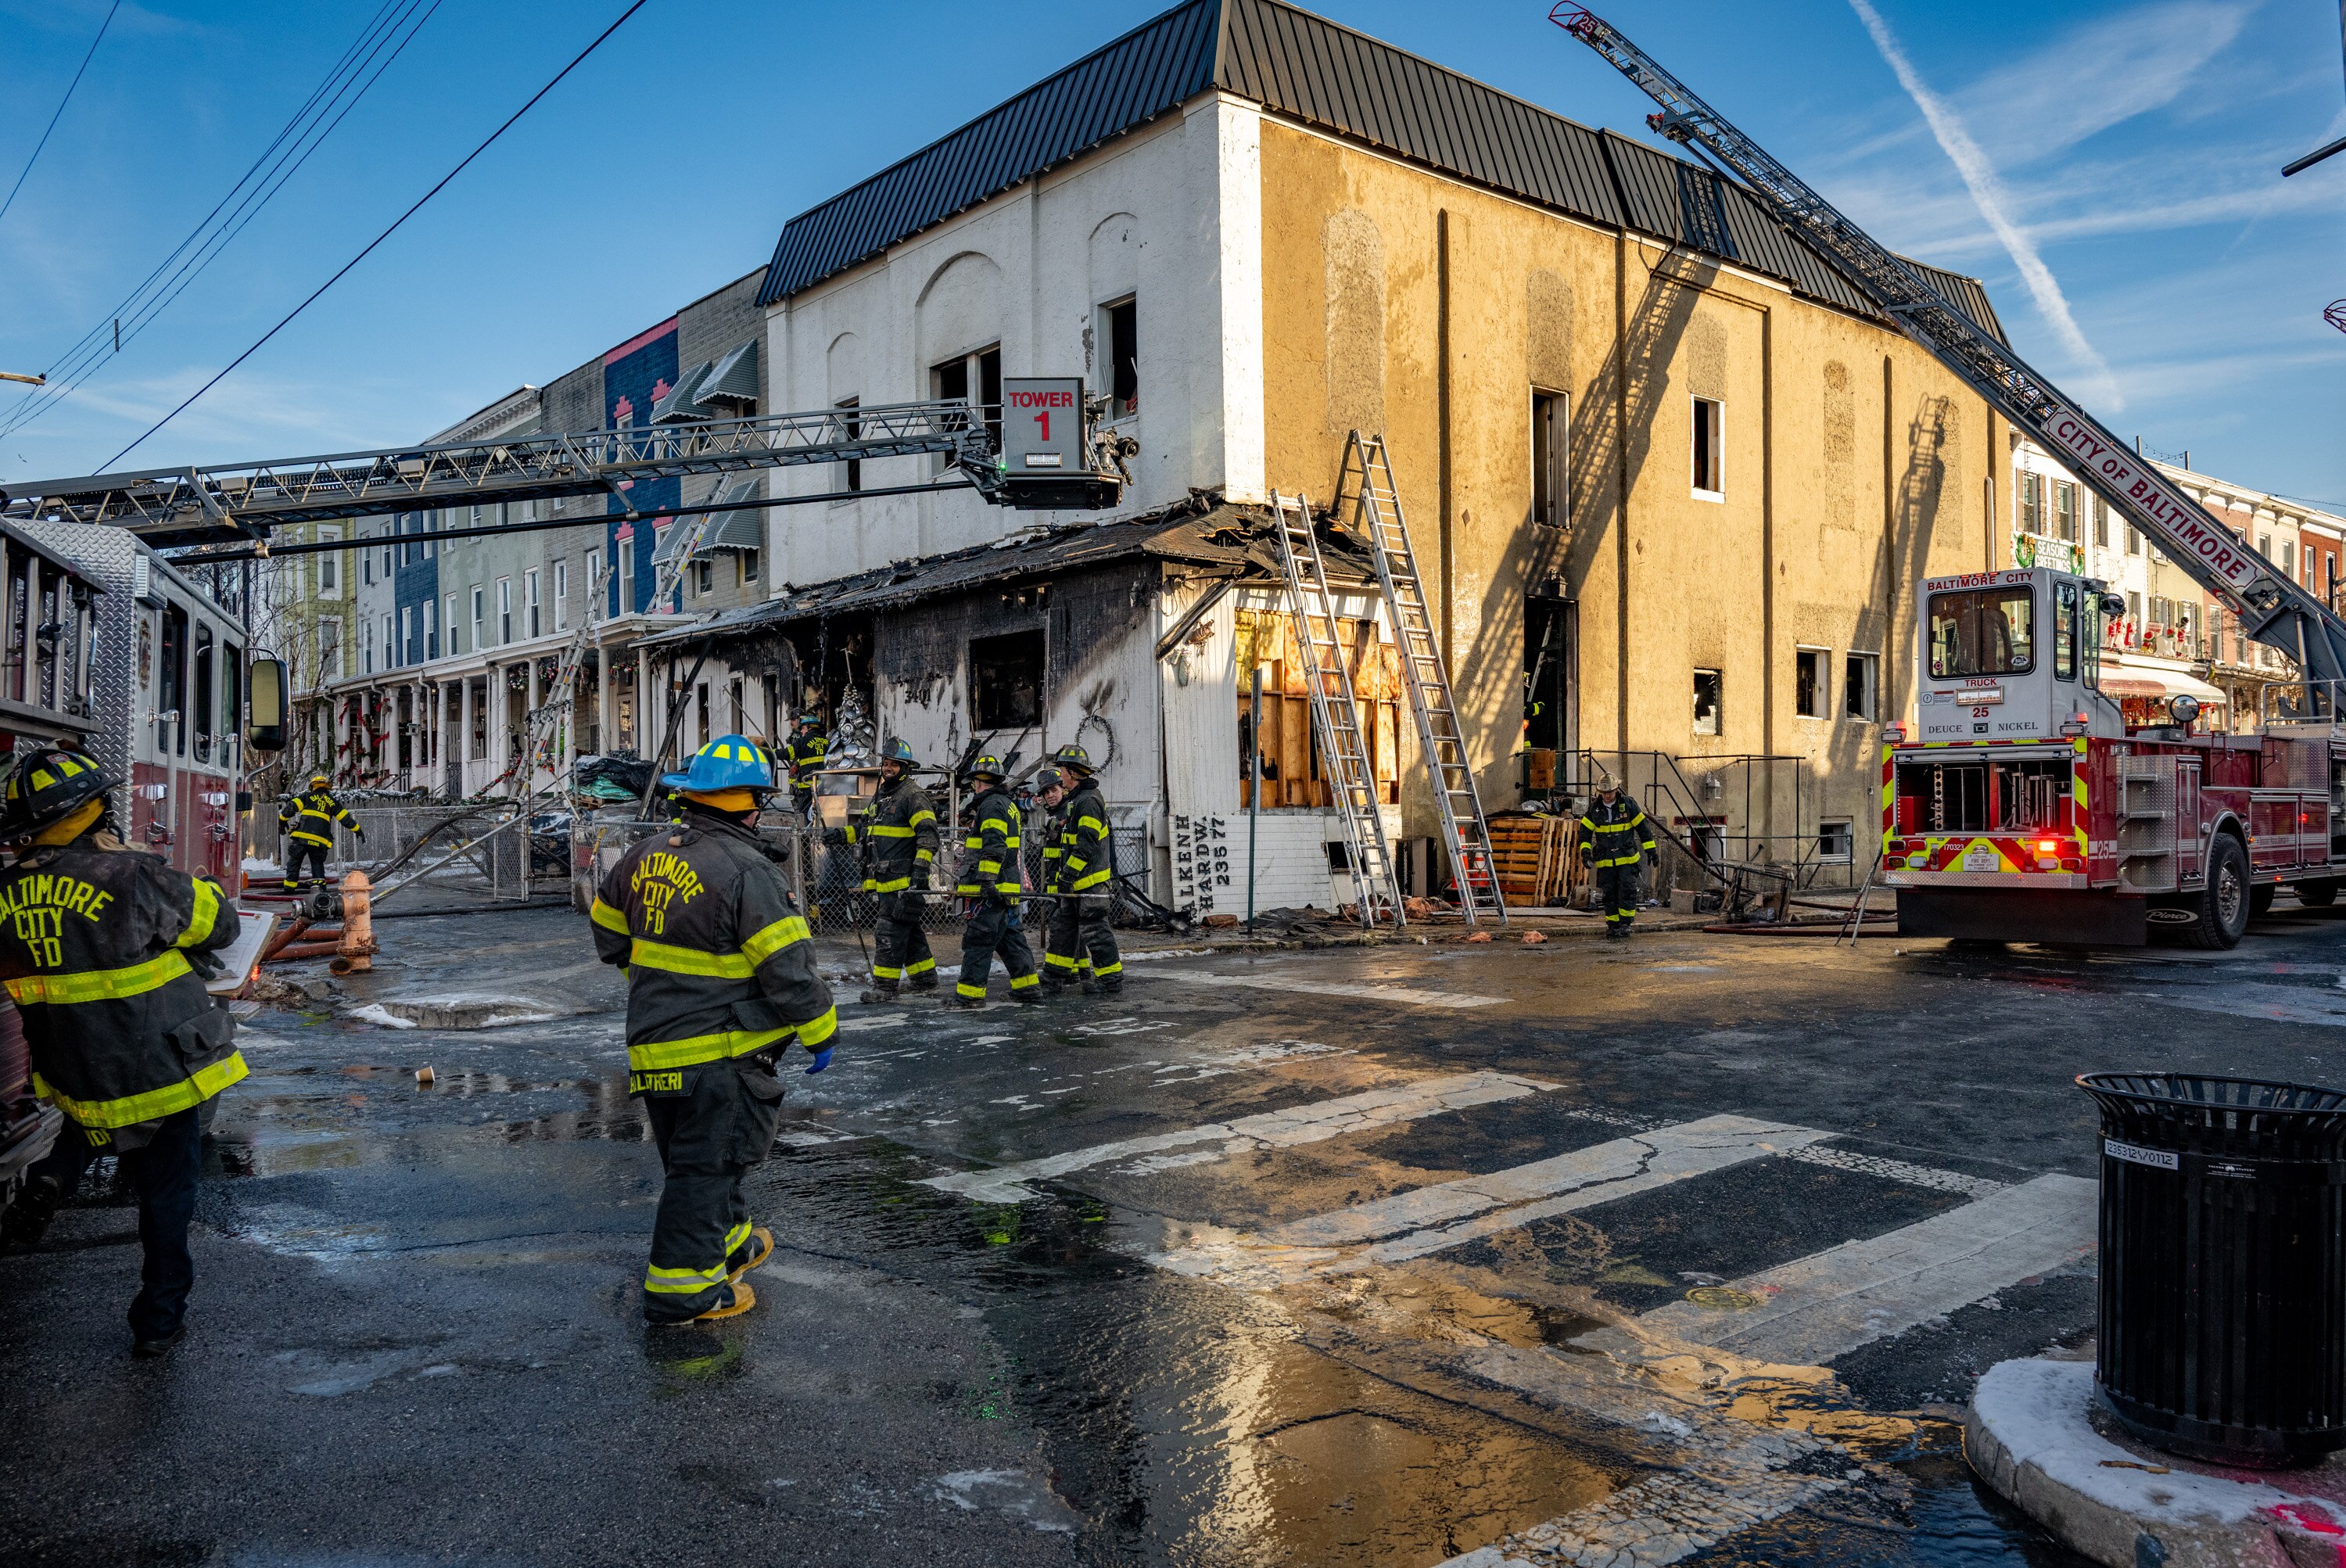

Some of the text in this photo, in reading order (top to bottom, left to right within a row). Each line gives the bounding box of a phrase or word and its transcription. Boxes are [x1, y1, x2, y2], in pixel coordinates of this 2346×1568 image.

[1579, 16, 1596, 33] 25
[1009, 392, 1073, 407] TOWER
[1034, 411, 1049, 441] 1
[2057, 420, 2247, 580] CITY OF BALTIMORE
[2037, 540, 2068, 559] SEASONS
[2035, 554, 2072, 573] GREETINGS
[1928, 572, 2033, 590] BALTIMORE CITY
[2217, 594, 2237, 609] Pierce
[1964, 678, 1996, 687] TRUCK
[1972, 707, 1989, 717] 25
[1928, 722, 2038, 733] DEUCE NICKEL
[310, 794, 335, 807] BALMORE
[2098, 840, 2109, 859] 25
[631, 852, 705, 904] BALTIMORE
[0, 874, 114, 923] ALTIMORE
[643, 880, 676, 910] CITY
[14, 907, 64, 940] CITY
[644, 906, 665, 935] FD
[2148, 910, 2188, 920] Pierce
[27, 937, 63, 967] FD
